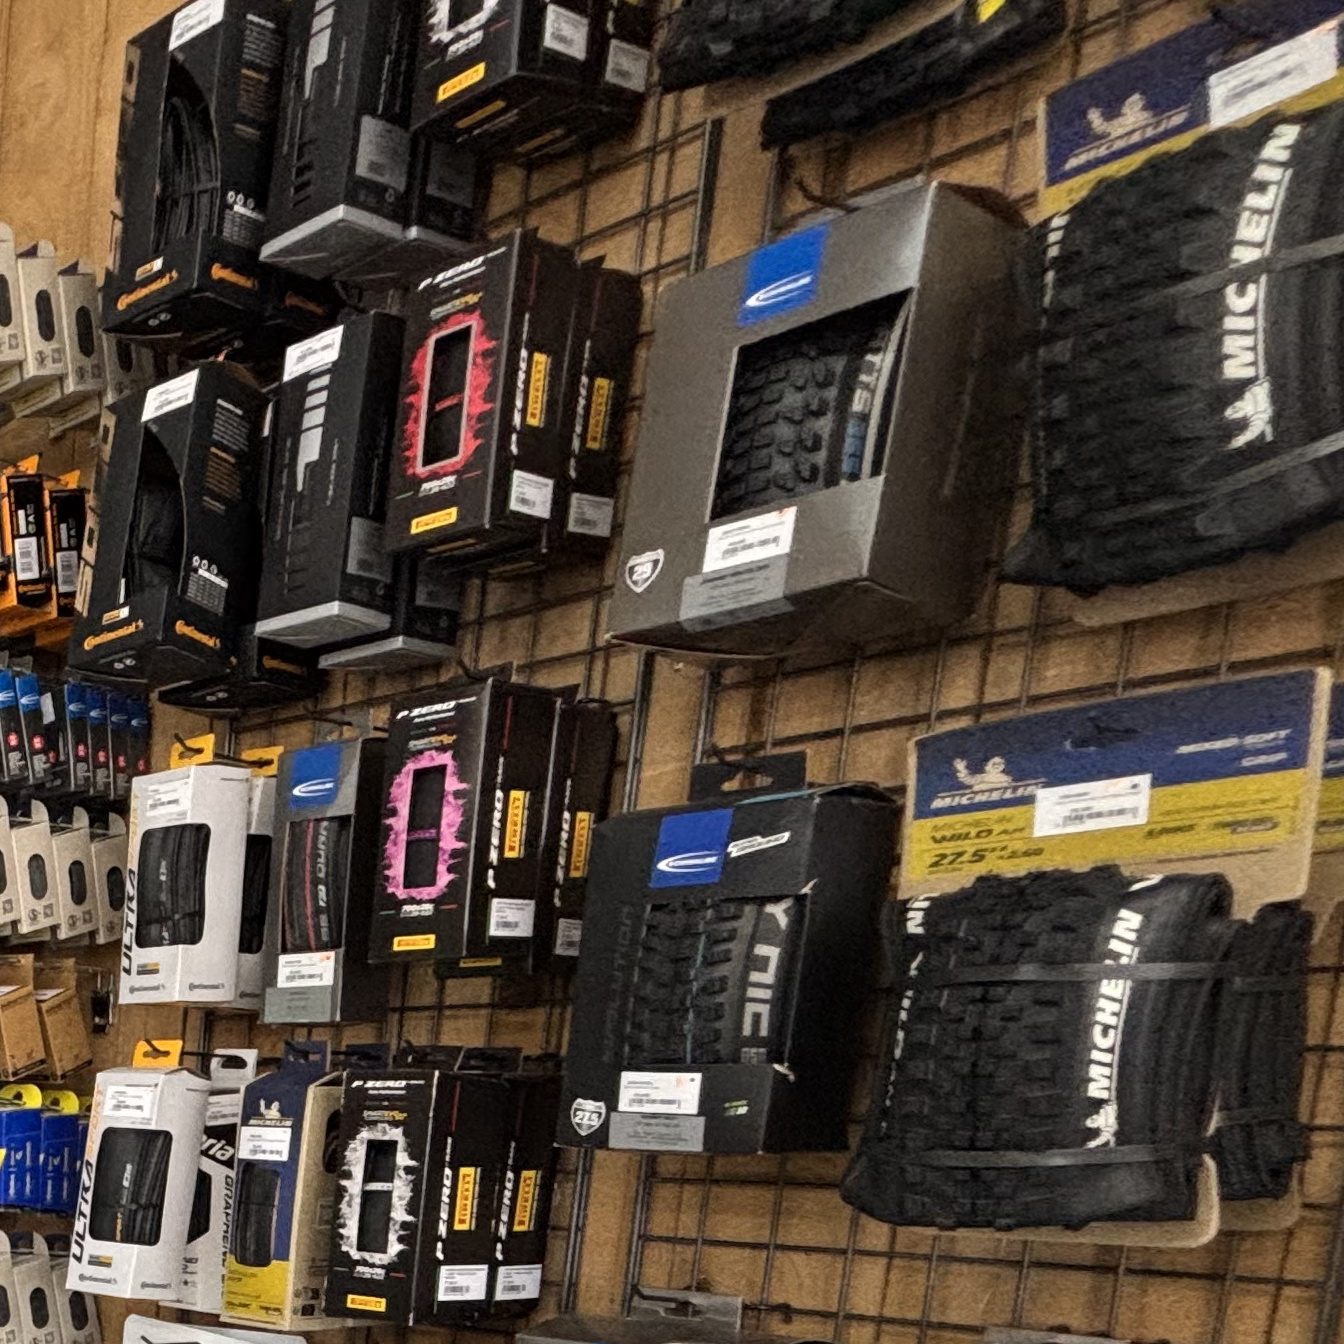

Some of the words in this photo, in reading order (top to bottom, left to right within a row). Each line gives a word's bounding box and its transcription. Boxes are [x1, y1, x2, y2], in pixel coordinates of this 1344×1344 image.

[631, 562, 654, 580] 29
[122, 867, 137, 976] ULTRA
[364, 1079, 407, 1089] ZERO
[71, 1159, 95, 1265] ULTRA
[437, 1168, 452, 1240] ZERO
[499, 1170, 515, 1242] ZERO
